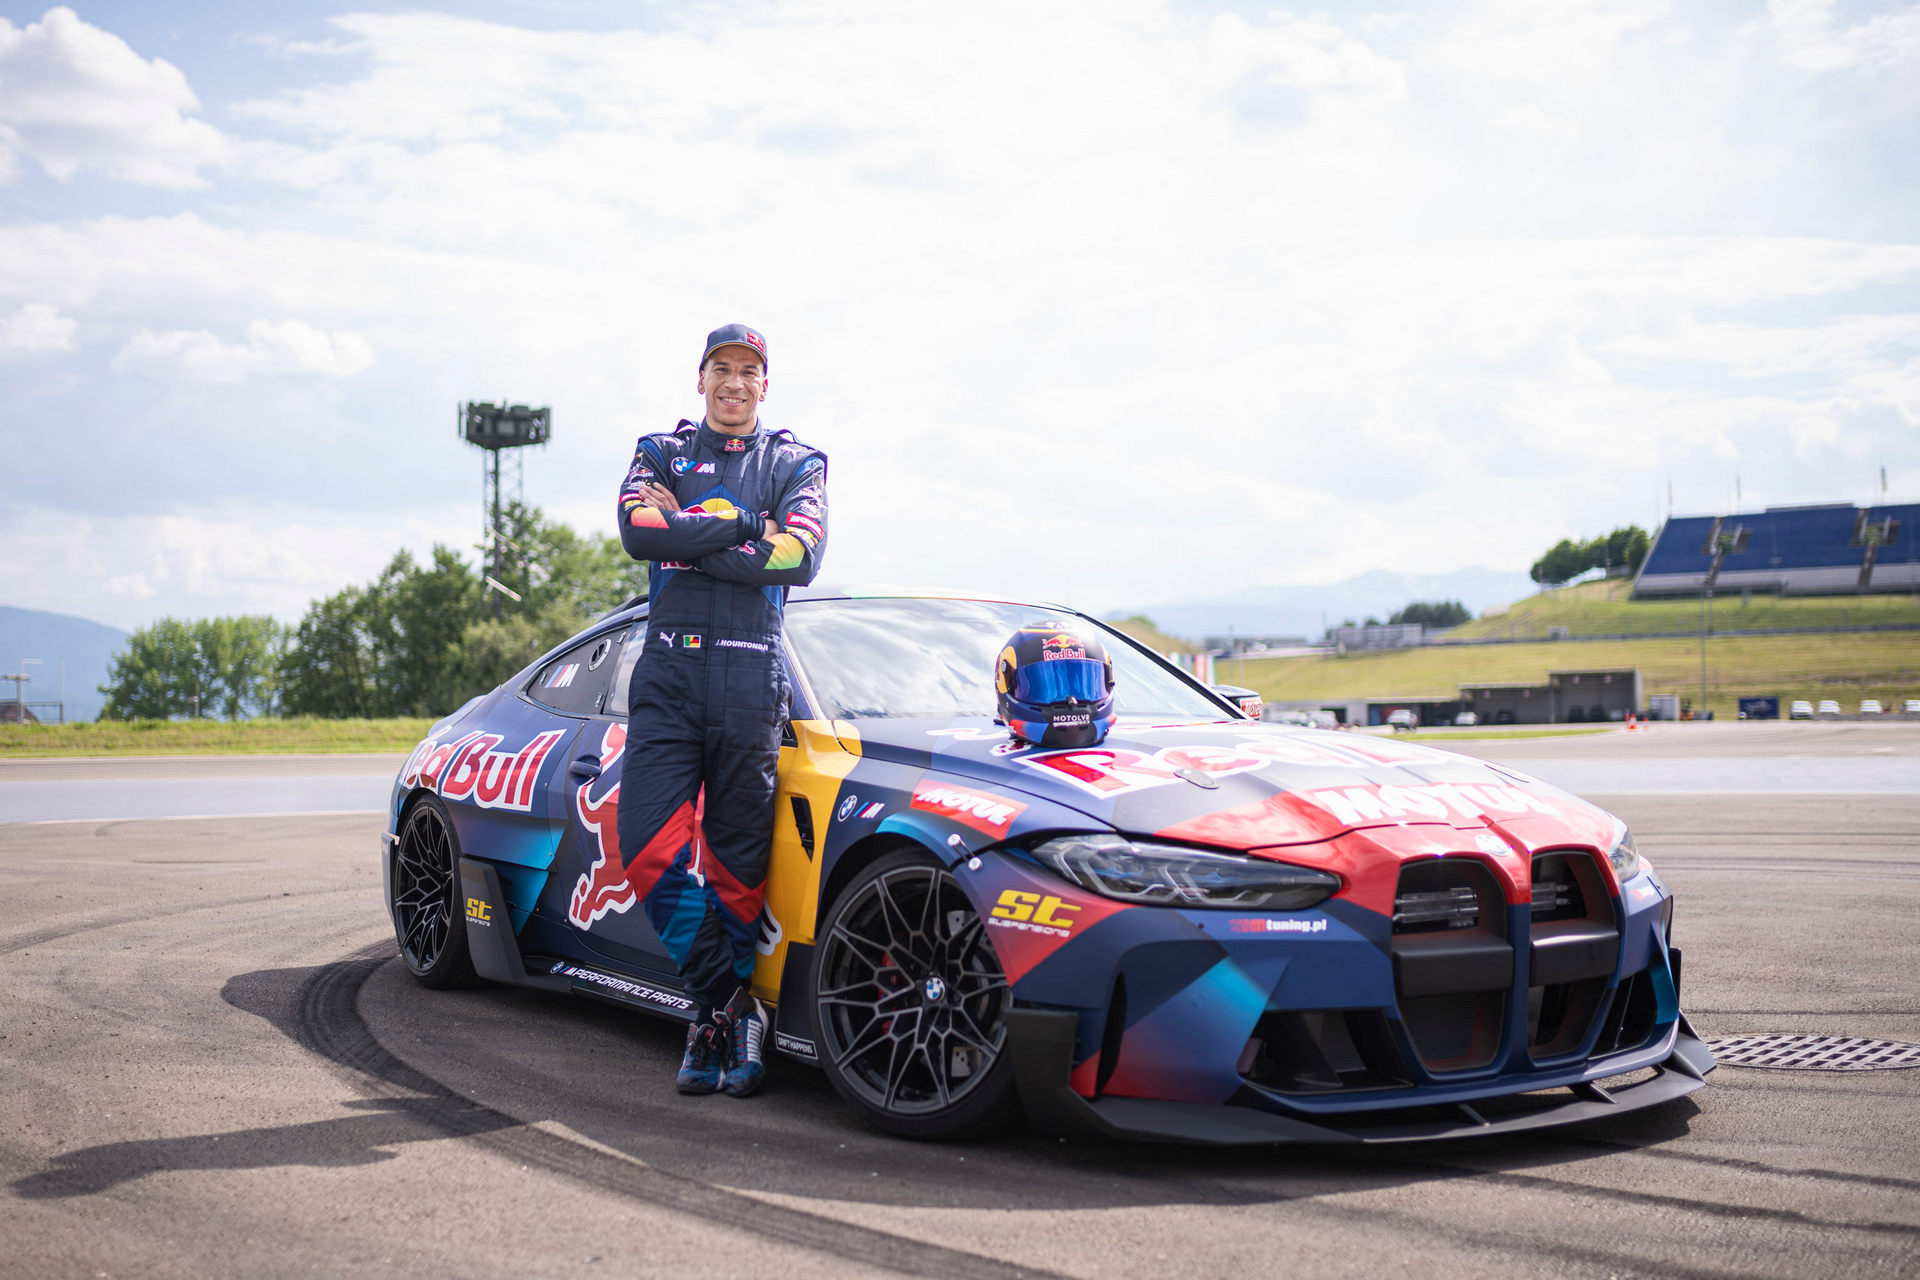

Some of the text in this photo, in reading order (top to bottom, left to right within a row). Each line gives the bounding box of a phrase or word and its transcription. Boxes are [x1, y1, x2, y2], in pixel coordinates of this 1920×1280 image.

[1044, 648, 1086, 661] Red Bull
[441, 729, 567, 812] Bull
[915, 788, 1015, 826] MOTUL
[573, 968, 655, 1000] PERFORMANCE
[648, 991, 693, 1010] PARTS
